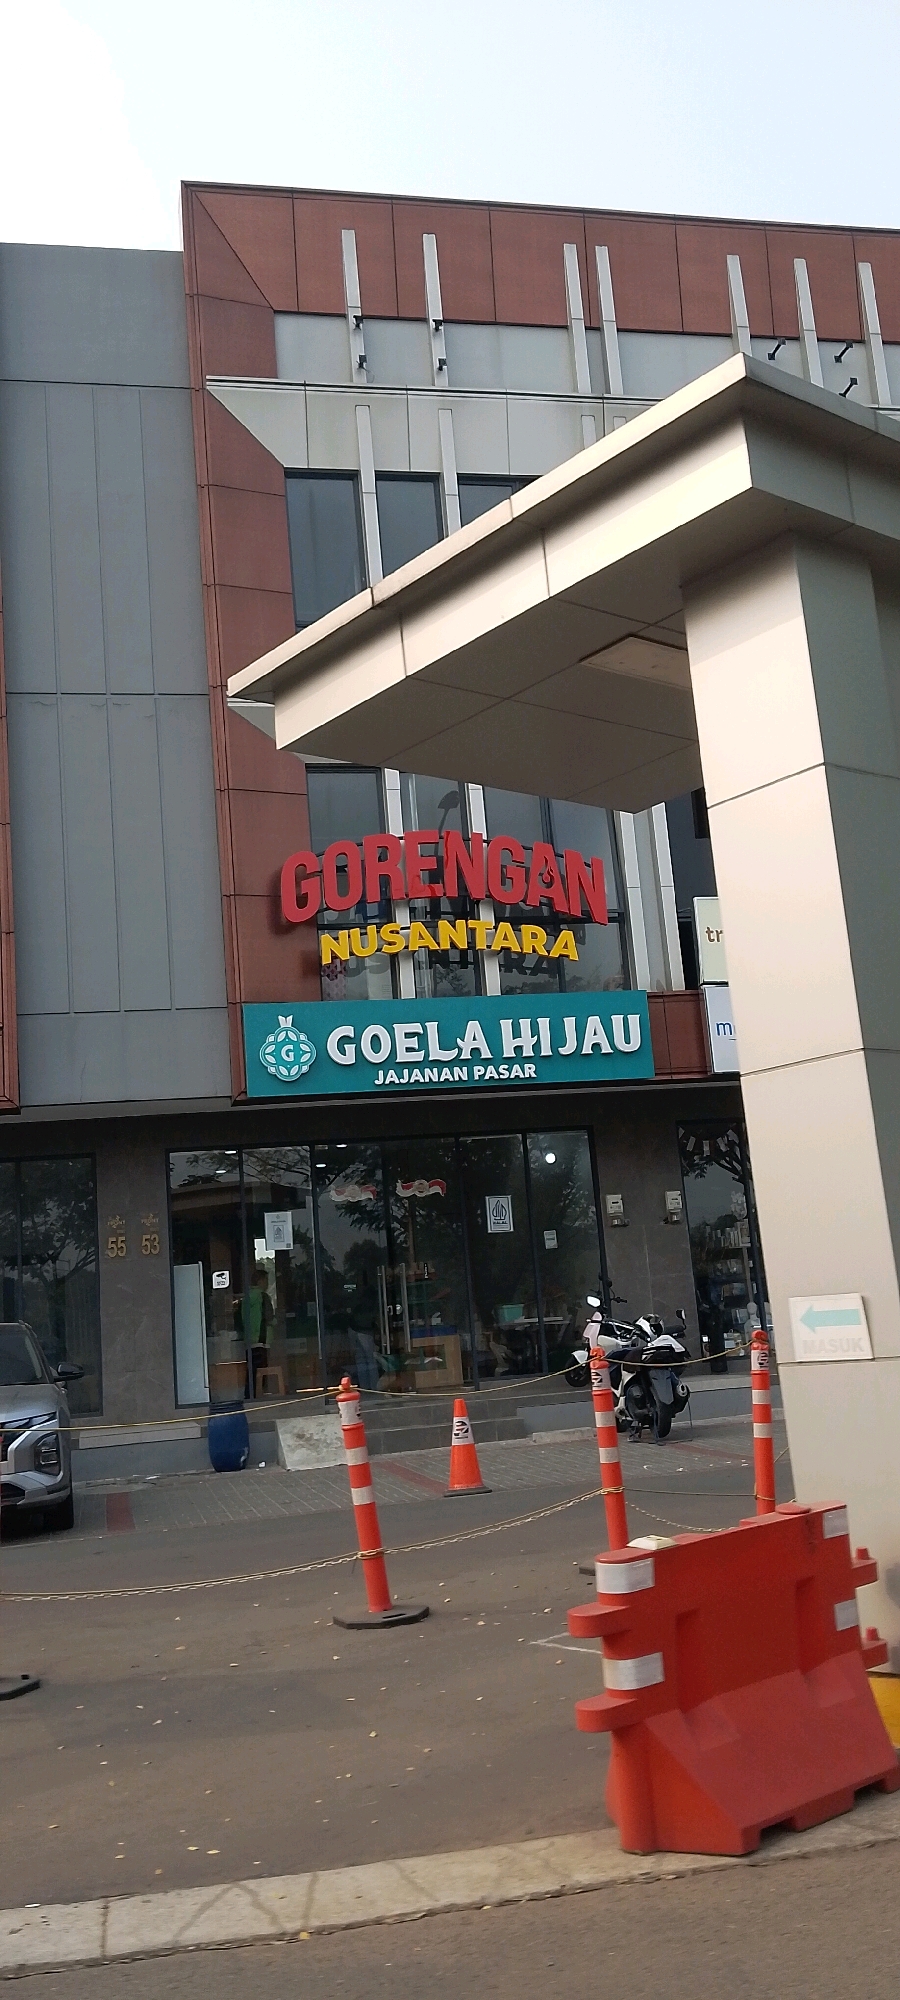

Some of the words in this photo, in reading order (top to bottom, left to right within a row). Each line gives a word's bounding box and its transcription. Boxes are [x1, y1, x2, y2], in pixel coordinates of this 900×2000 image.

[280, 830, 608, 925] GORENGAN
[320, 919, 579, 965] NUSANTARA
[326, 1020, 493, 1065] GOELA
[500, 1014, 642, 1059] HIJAU
[715, 1022, 736, 1037] m
[374, 1066, 468, 1086] JAJANAN
[473, 1063, 537, 1080] PASAR
[107, 1236, 127, 1258] 55
[141, 1234, 160, 1255] 53
[802, 1337, 865, 1355] MASUK
